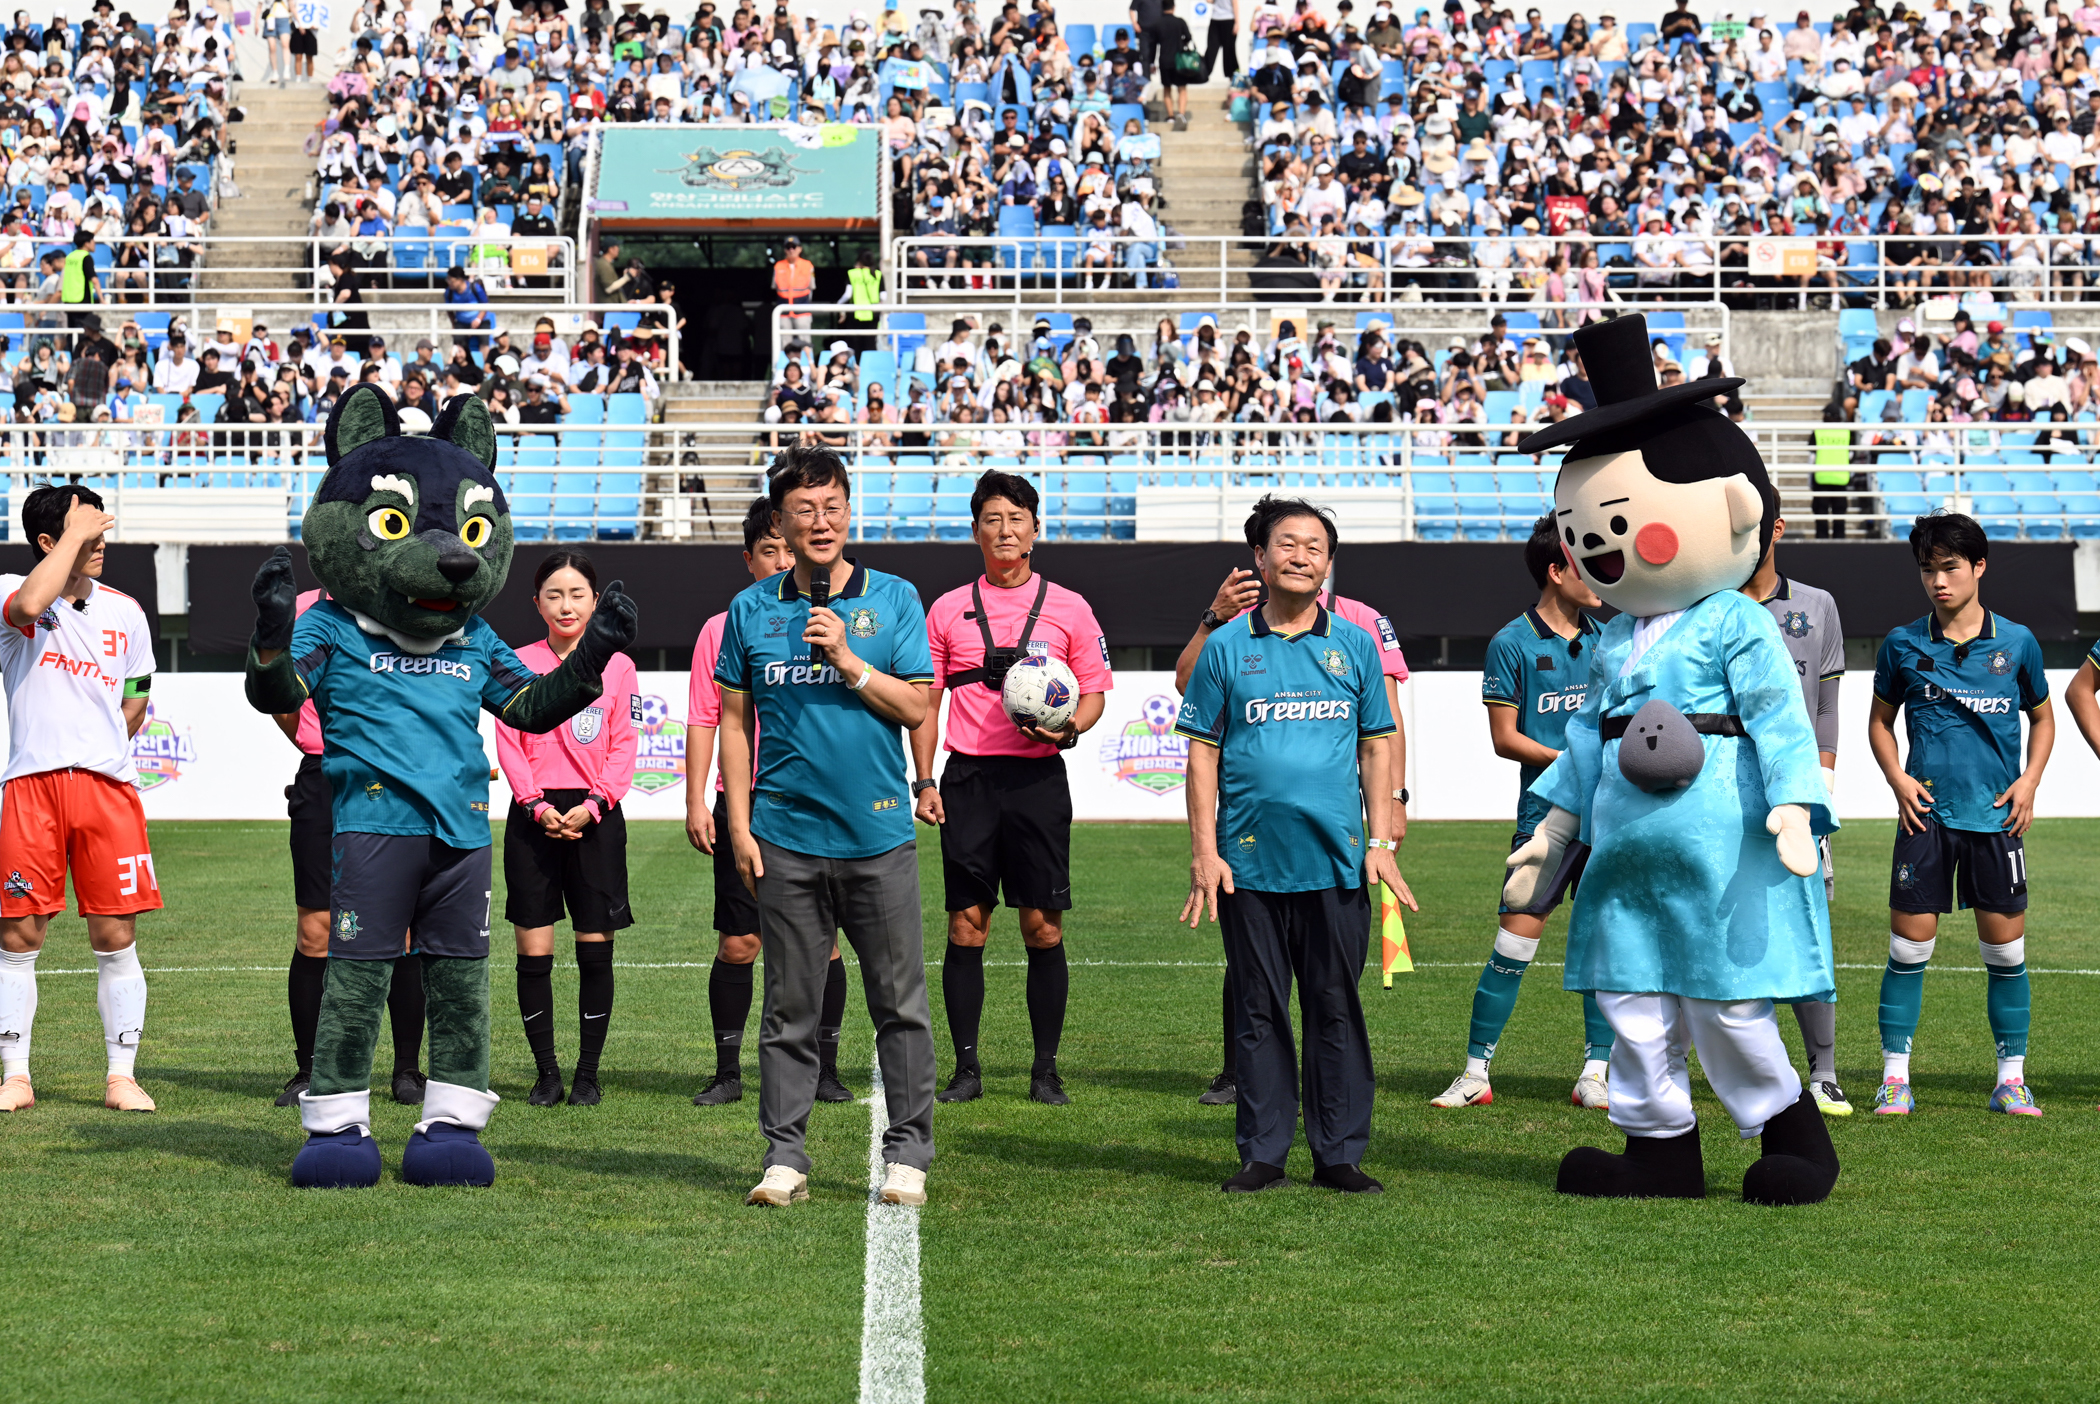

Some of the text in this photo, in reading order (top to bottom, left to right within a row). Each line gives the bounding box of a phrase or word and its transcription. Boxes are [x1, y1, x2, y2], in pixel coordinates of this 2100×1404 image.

[520, 255, 539, 266] E16
[102, 629, 128, 658] 37
[764, 631, 790, 639] hummel
[369, 651, 472, 682] Greeners
[1240, 668, 1267, 677] hummel
[1274, 691, 1303, 699] ANSAN
[1245, 697, 1351, 725] Greeners
[117, 853, 158, 896] 37
[2007, 848, 2026, 884] 11
